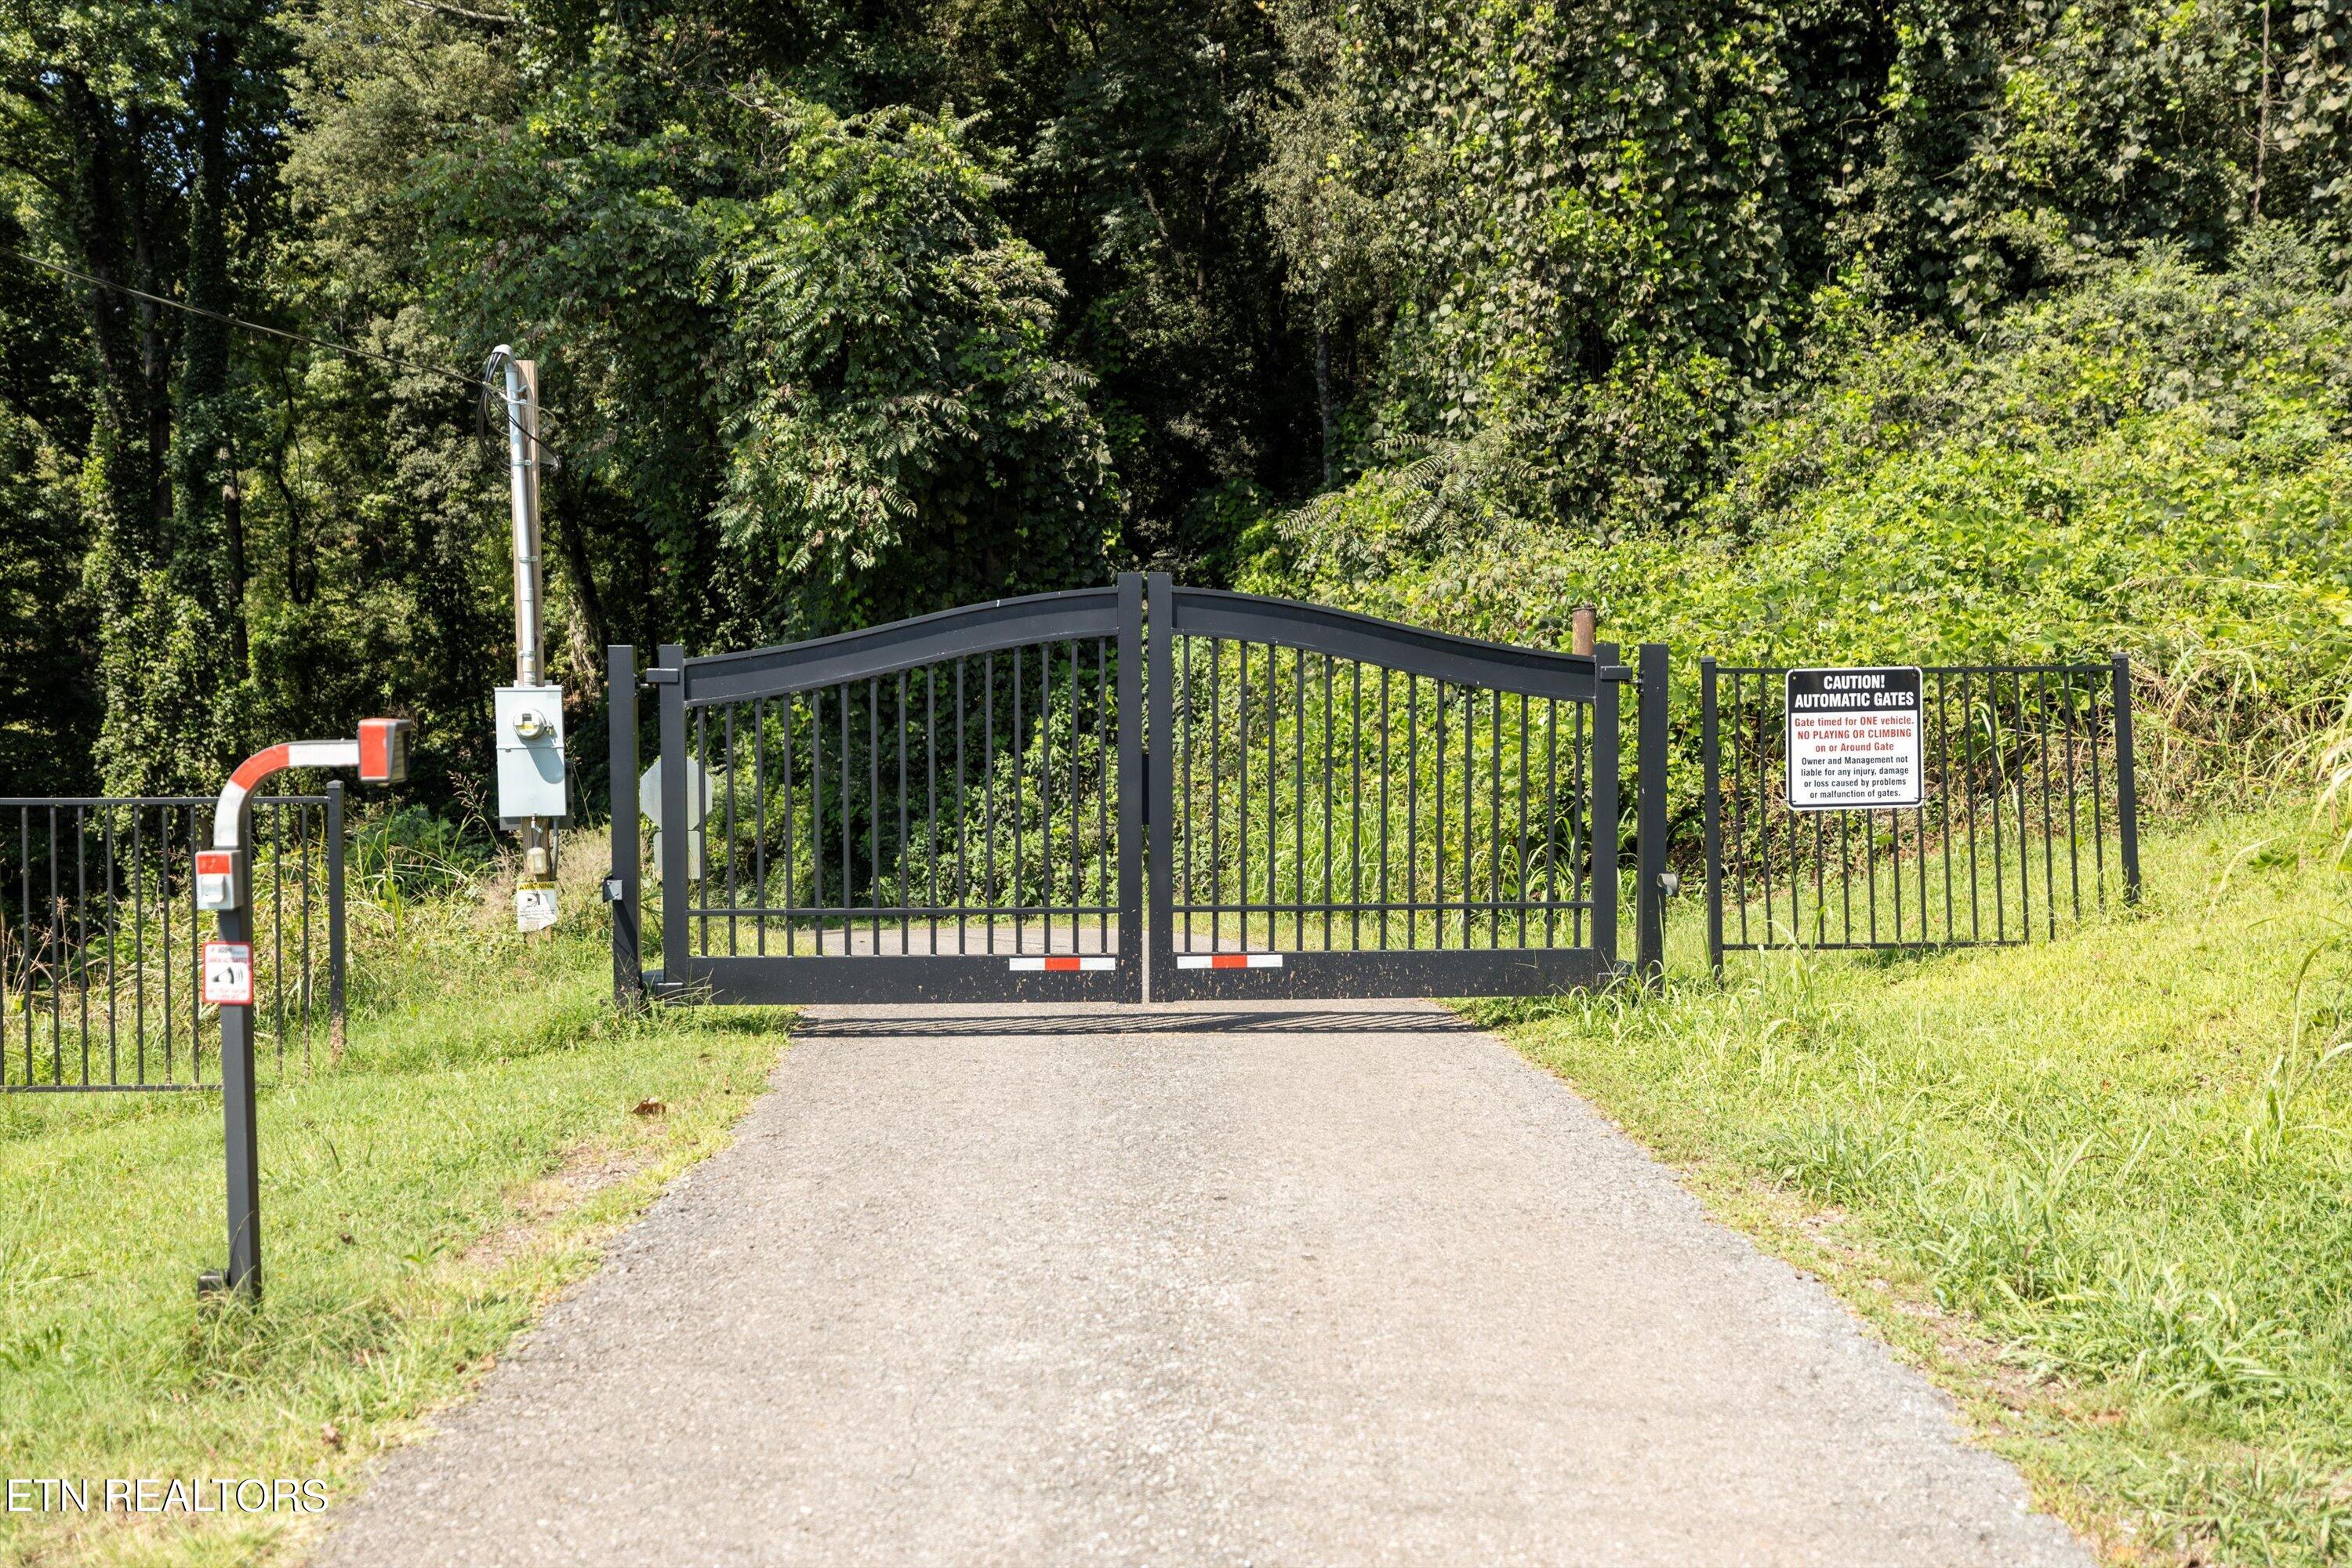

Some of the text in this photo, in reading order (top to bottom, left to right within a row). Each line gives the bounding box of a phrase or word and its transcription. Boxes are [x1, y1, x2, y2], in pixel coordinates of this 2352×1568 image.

[1824, 675, 1885, 689] CAUTION!
[1795, 691, 1914, 708] AUTOMATIC GATES
[1795, 718, 1814, 727] Gate
[1818, 717, 1842, 726] timed
[1860, 717, 1878, 725] ONE
[1881, 716, 1914, 724] vehicle.
[1868, 729, 1911, 738] CLIMBING
[1845, 756, 1893, 765] Management
